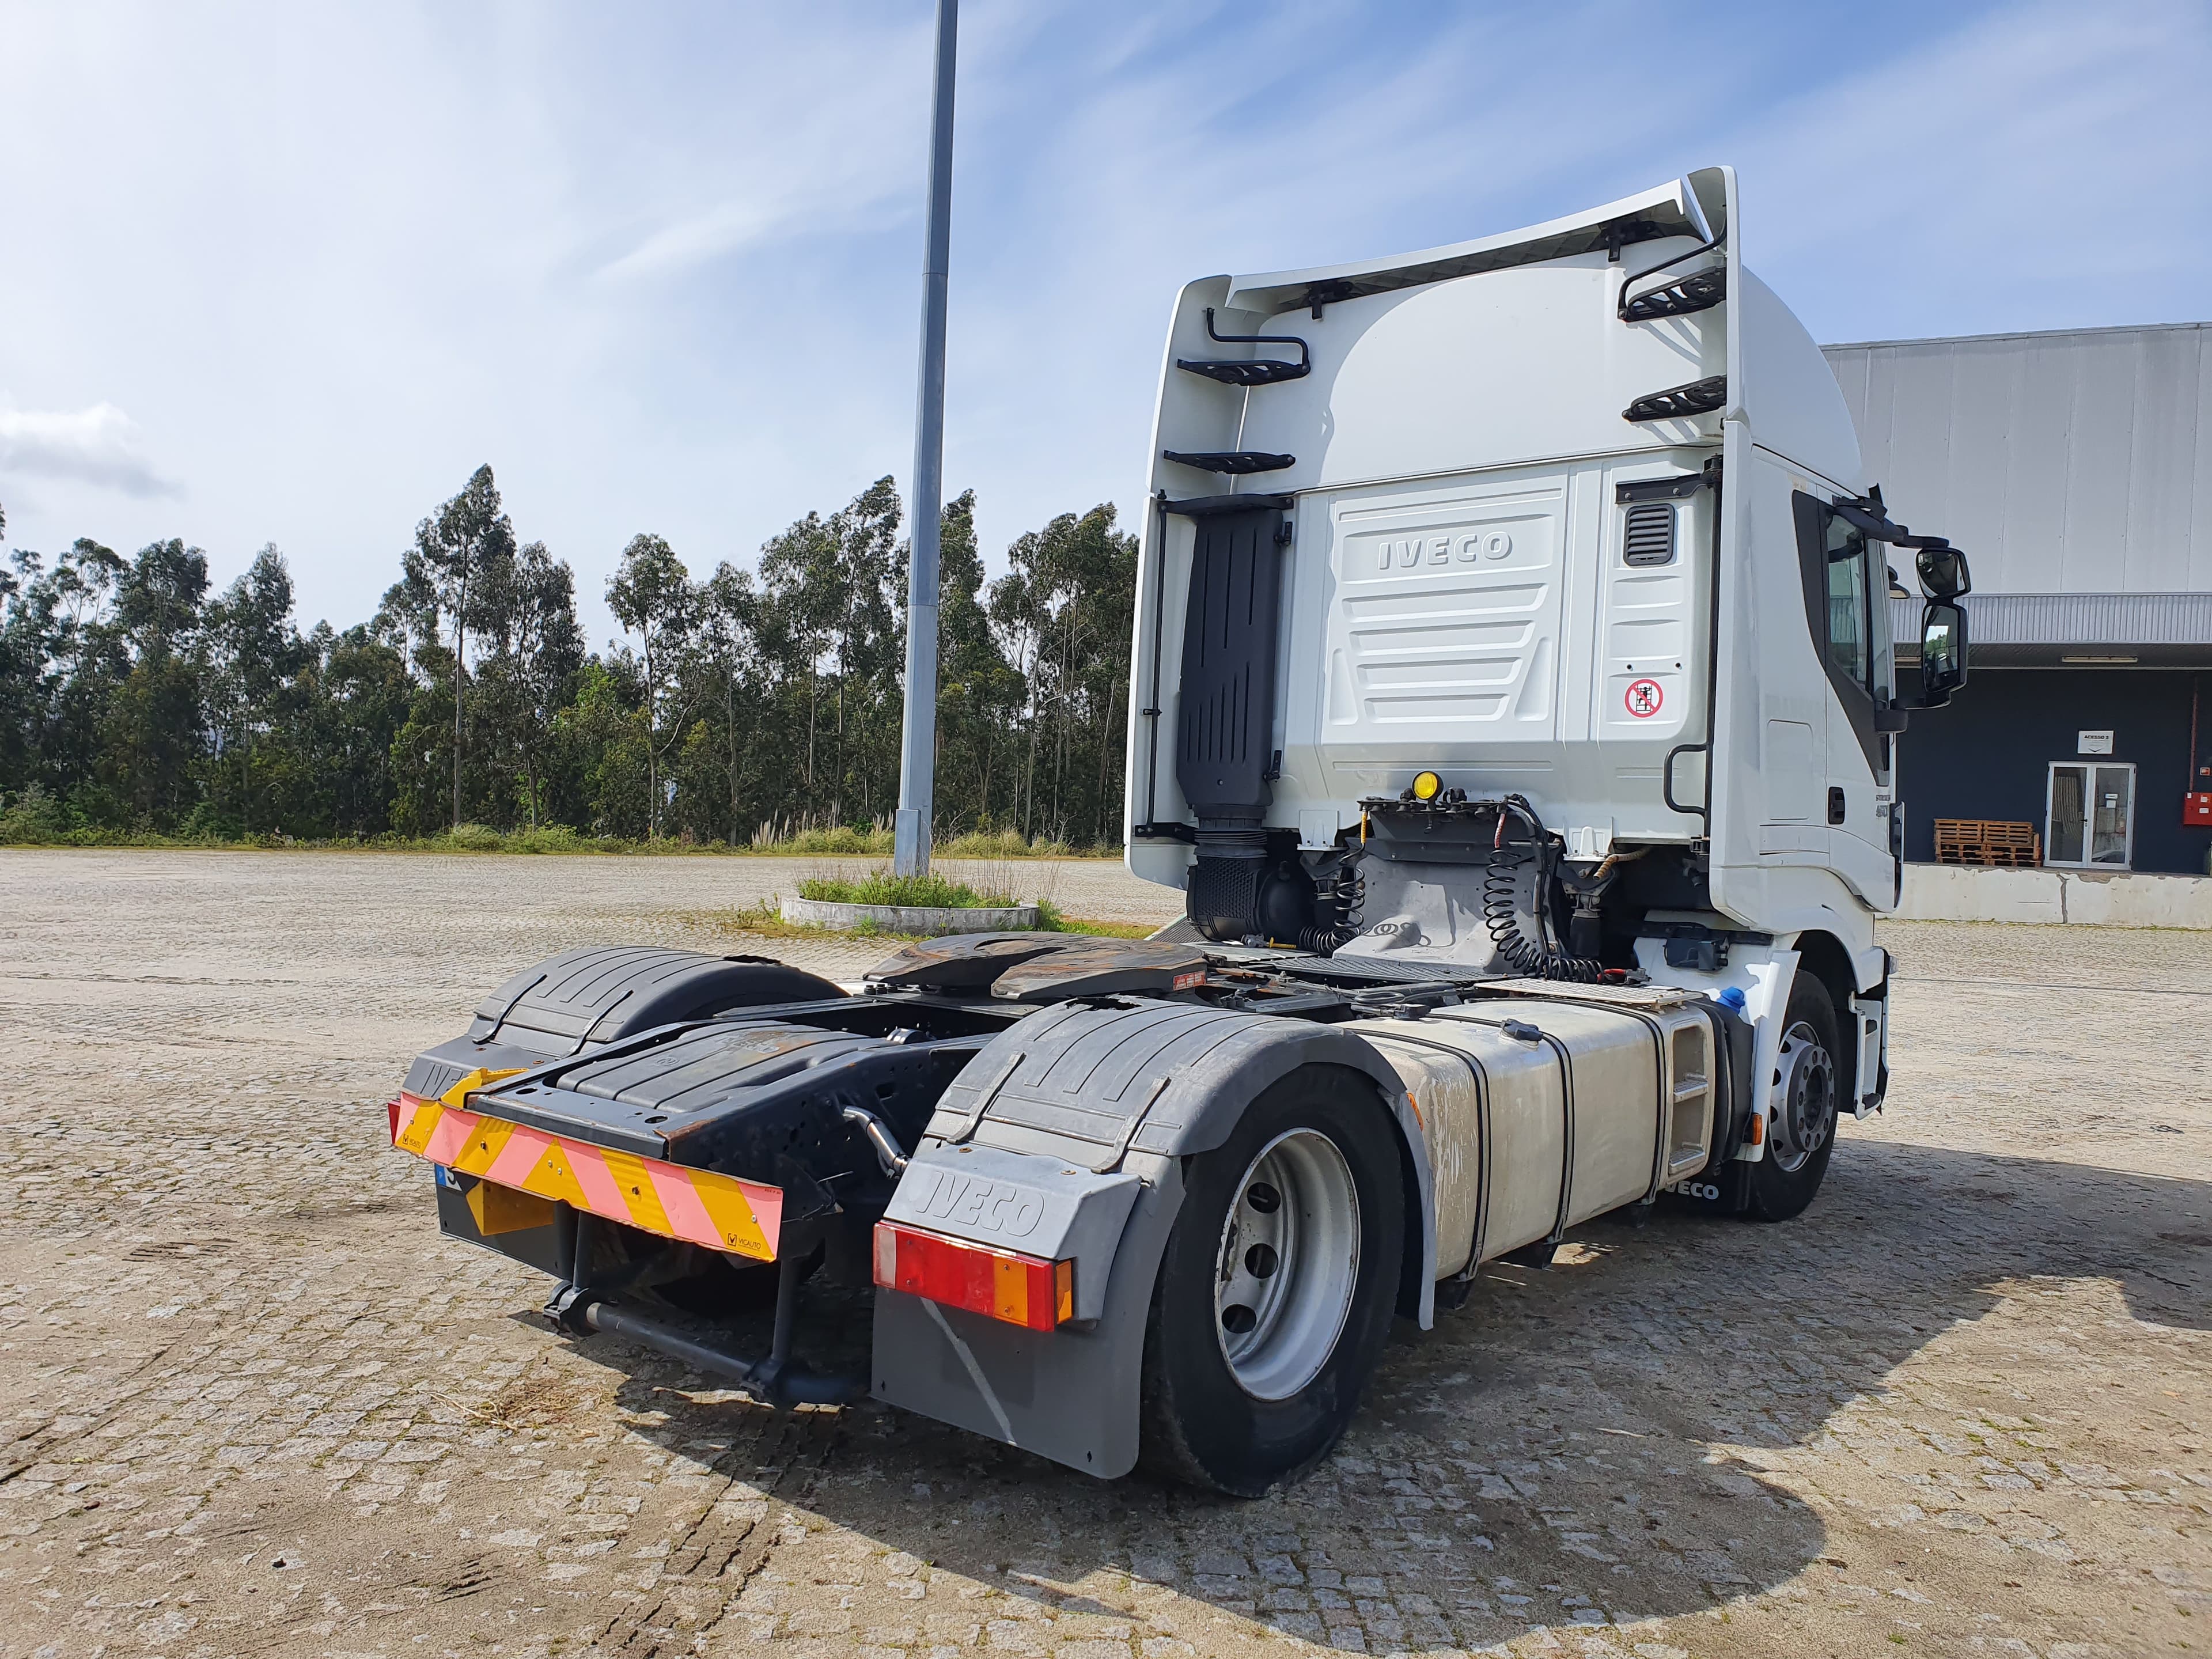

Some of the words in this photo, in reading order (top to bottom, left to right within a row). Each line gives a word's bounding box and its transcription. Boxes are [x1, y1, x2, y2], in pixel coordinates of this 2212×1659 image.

[1378, 531, 1513, 570] IVECO
[915, 1171, 1044, 1237] IVECO
[1665, 1180, 1719, 1199] VECO
[738, 1237, 761, 1249] VICAUTO
